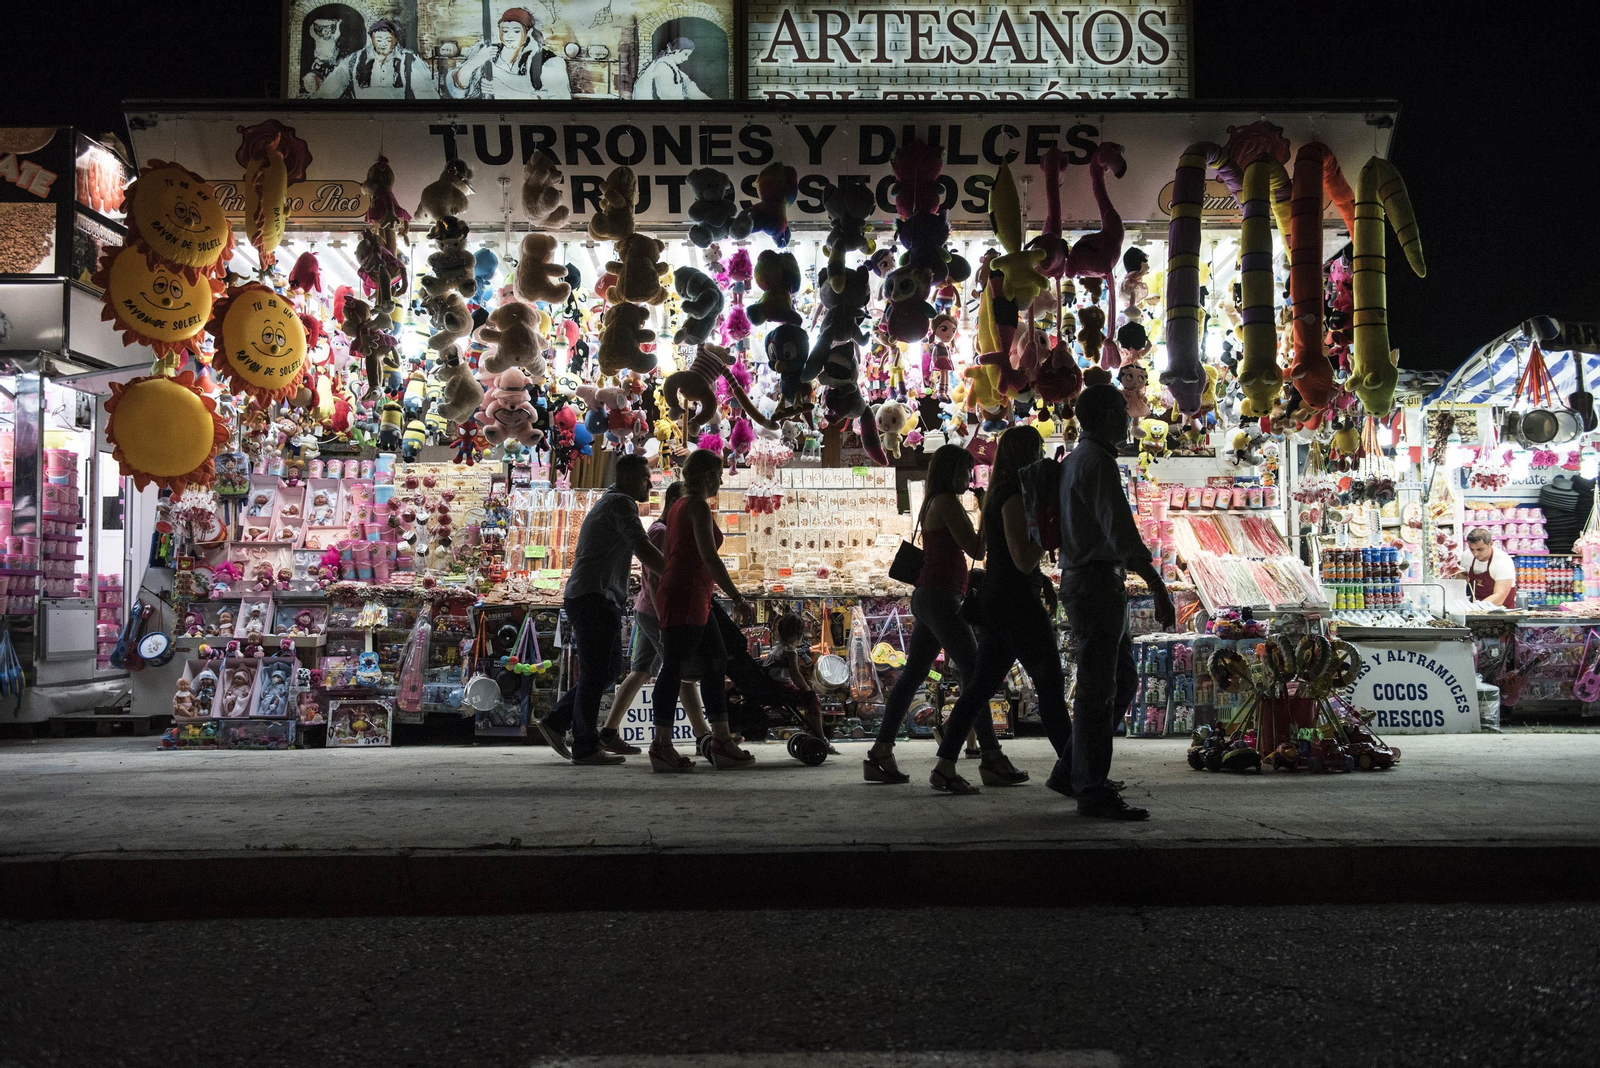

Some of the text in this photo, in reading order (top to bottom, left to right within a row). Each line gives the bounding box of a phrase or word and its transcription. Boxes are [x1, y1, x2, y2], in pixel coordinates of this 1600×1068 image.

[761, 10, 1170, 65] ARTESANOS
[429, 124, 774, 166] TURRONES
[796, 125, 837, 165] Y
[163, 178, 210, 202] TU ES UN
[309, 183, 361, 212] Picó
[150, 220, 222, 253] RAYON DE SOLEIL
[122, 298, 202, 331] RAYON DE SOLEIL
[252, 299, 293, 318] TU ES UN
[235, 349, 302, 378] RAYON DE SOLEIL
[1371, 653, 1382, 666] Y
[1387, 650, 1470, 714] ALTRAMUCES
[1373, 683, 1428, 701] COCOS
[623, 727, 644, 741] DE
